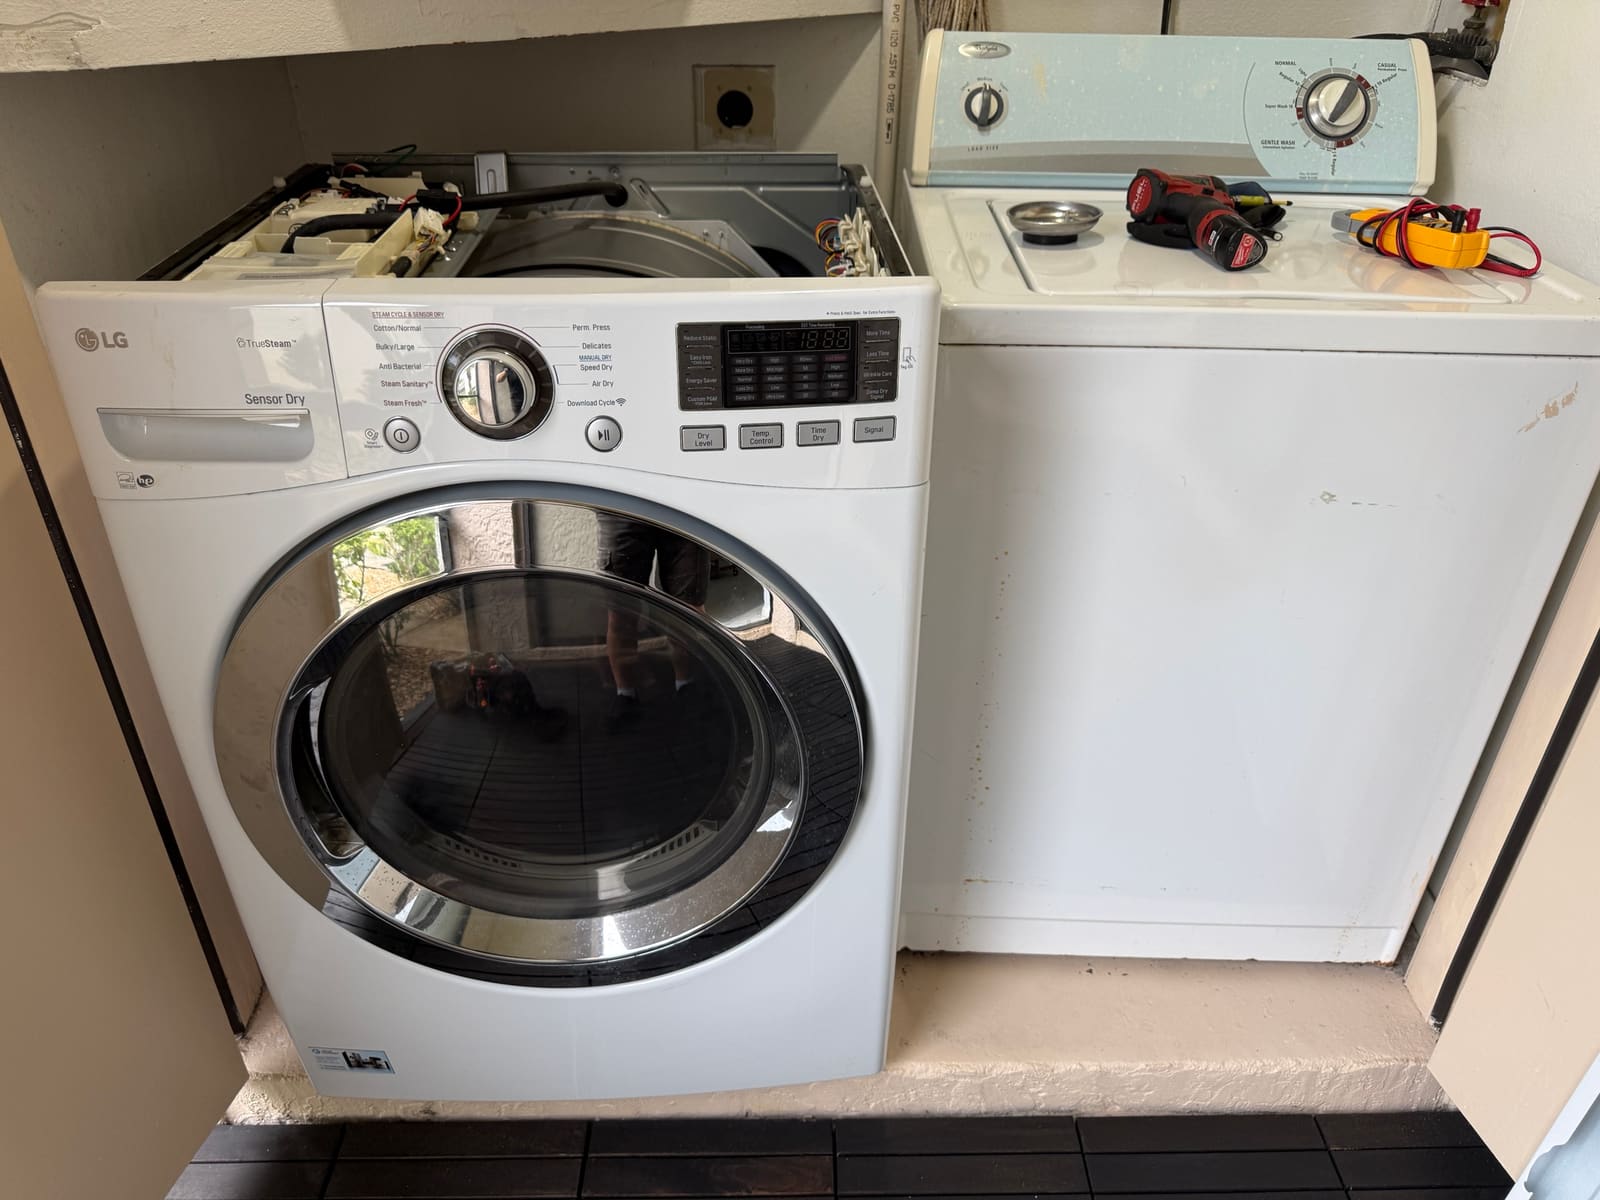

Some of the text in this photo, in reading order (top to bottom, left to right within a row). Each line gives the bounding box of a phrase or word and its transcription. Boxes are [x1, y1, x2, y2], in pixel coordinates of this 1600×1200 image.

[102, 331, 129, 349] LG
[580, 364, 613, 372] Speed Dry
[603, 380, 614, 388] Dry
[245, 394, 305, 406] Sensor Dry
[864, 426, 884, 435] Signal
[697, 432, 710, 440] Dry
[751, 430, 770, 440] Temp
[813, 433, 825, 442] Dry
[694, 439, 713, 447] Level
[750, 437, 774, 445] Control
